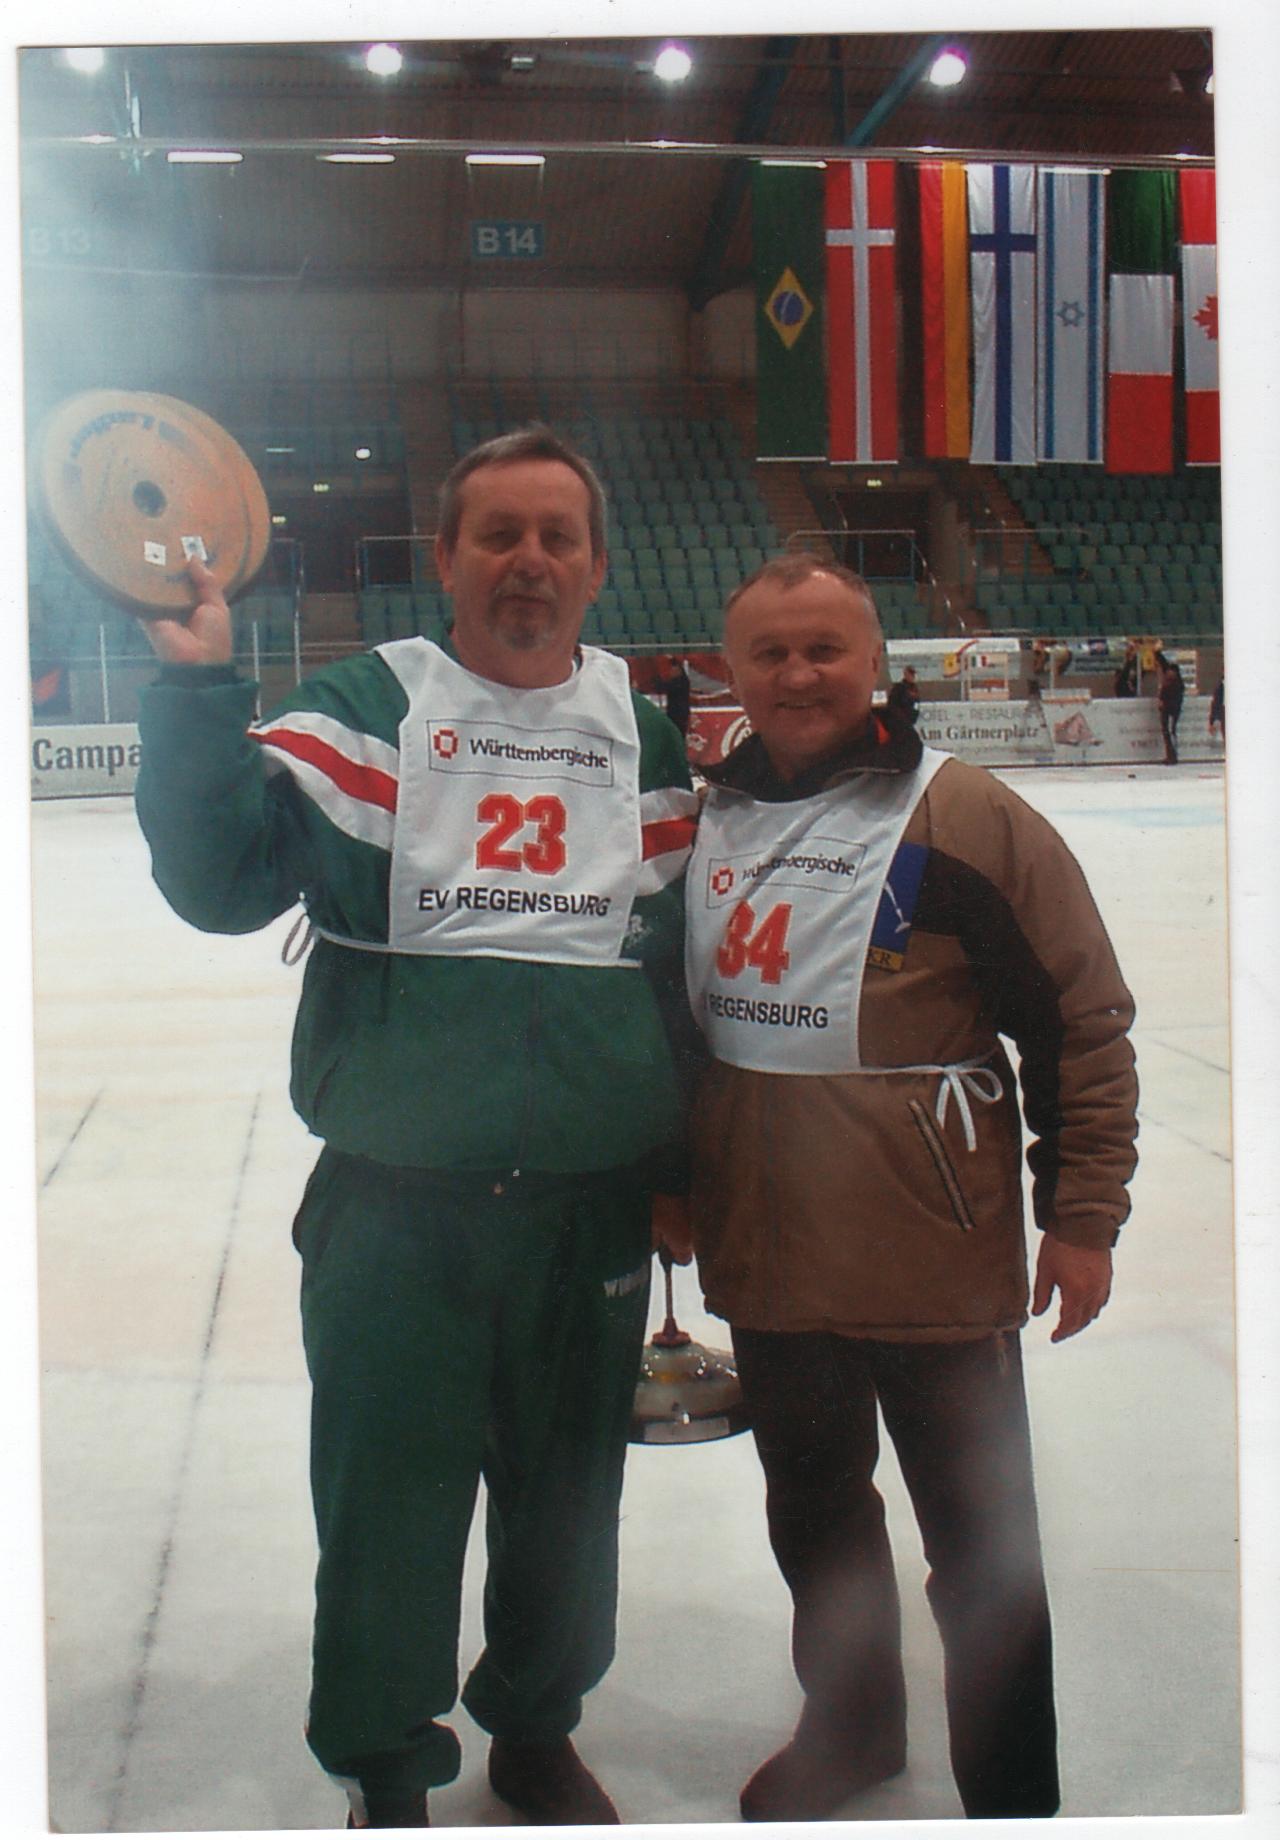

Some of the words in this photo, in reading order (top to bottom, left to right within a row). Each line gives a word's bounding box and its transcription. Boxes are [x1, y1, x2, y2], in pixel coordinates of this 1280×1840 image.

[919, 708, 949, 721] OTEL
[33, 738, 141, 777] Campa
[470, 737, 608, 769] Württembergische
[475, 792, 567, 876] 23
[418, 888, 450, 911] EV
[456, 886, 611, 917] REGENSBURG
[716, 897, 793, 985] 34
